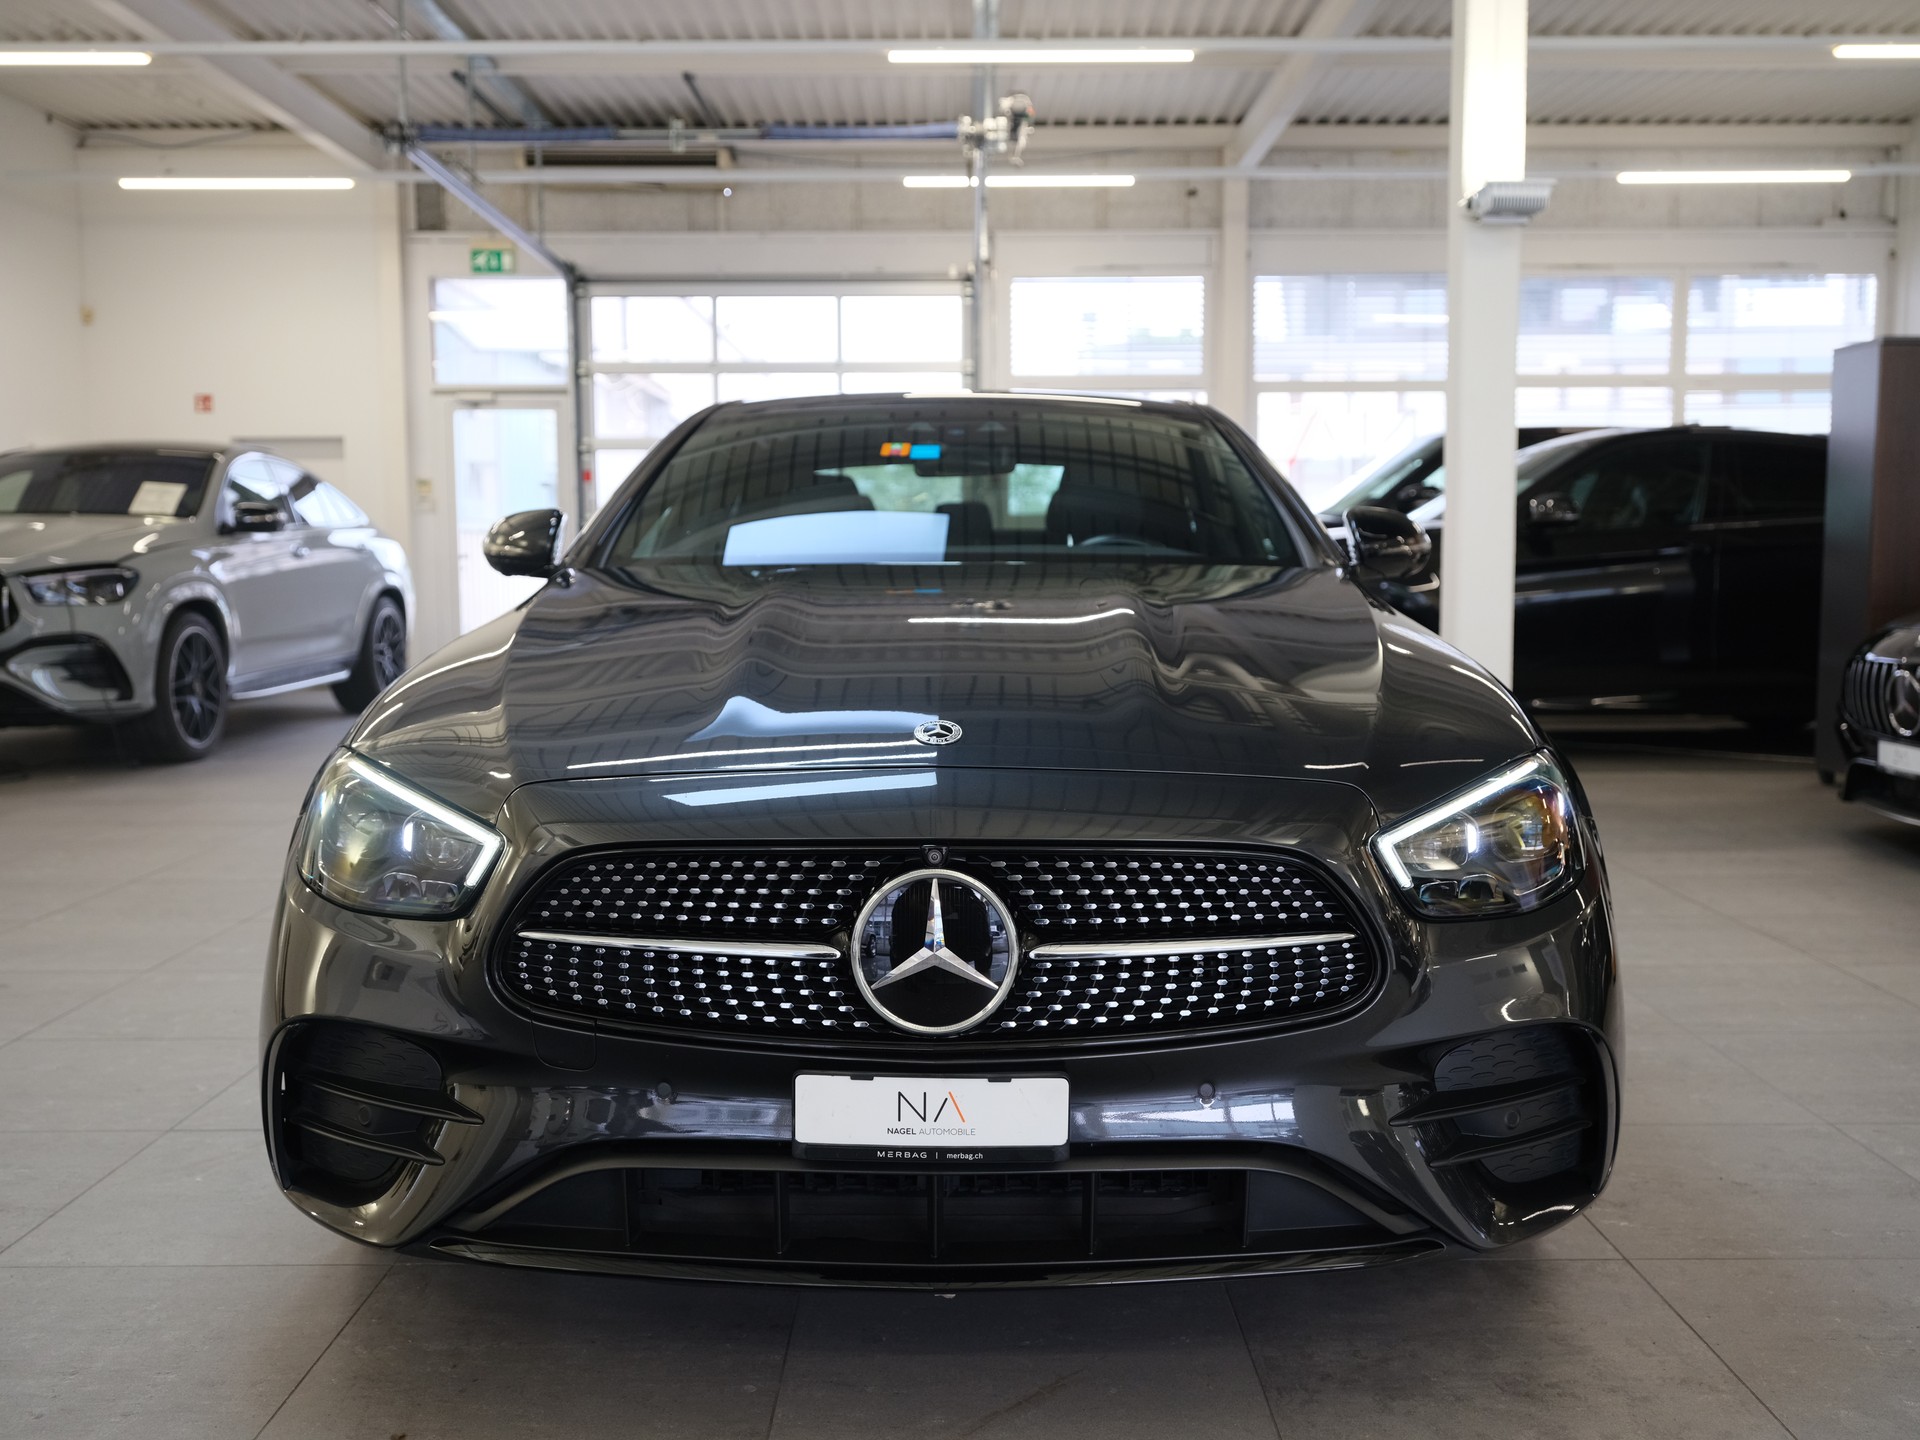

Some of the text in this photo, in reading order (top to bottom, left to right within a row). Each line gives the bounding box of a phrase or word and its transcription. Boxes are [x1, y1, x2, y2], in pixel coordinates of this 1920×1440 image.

[897, 1091, 966, 1123] NA
[886, 1127, 976, 1136] NAGEL AUTOMOBILE
[876, 1150, 928, 1159] MERBAG
[946, 1152, 984, 1161] merbag.ch
